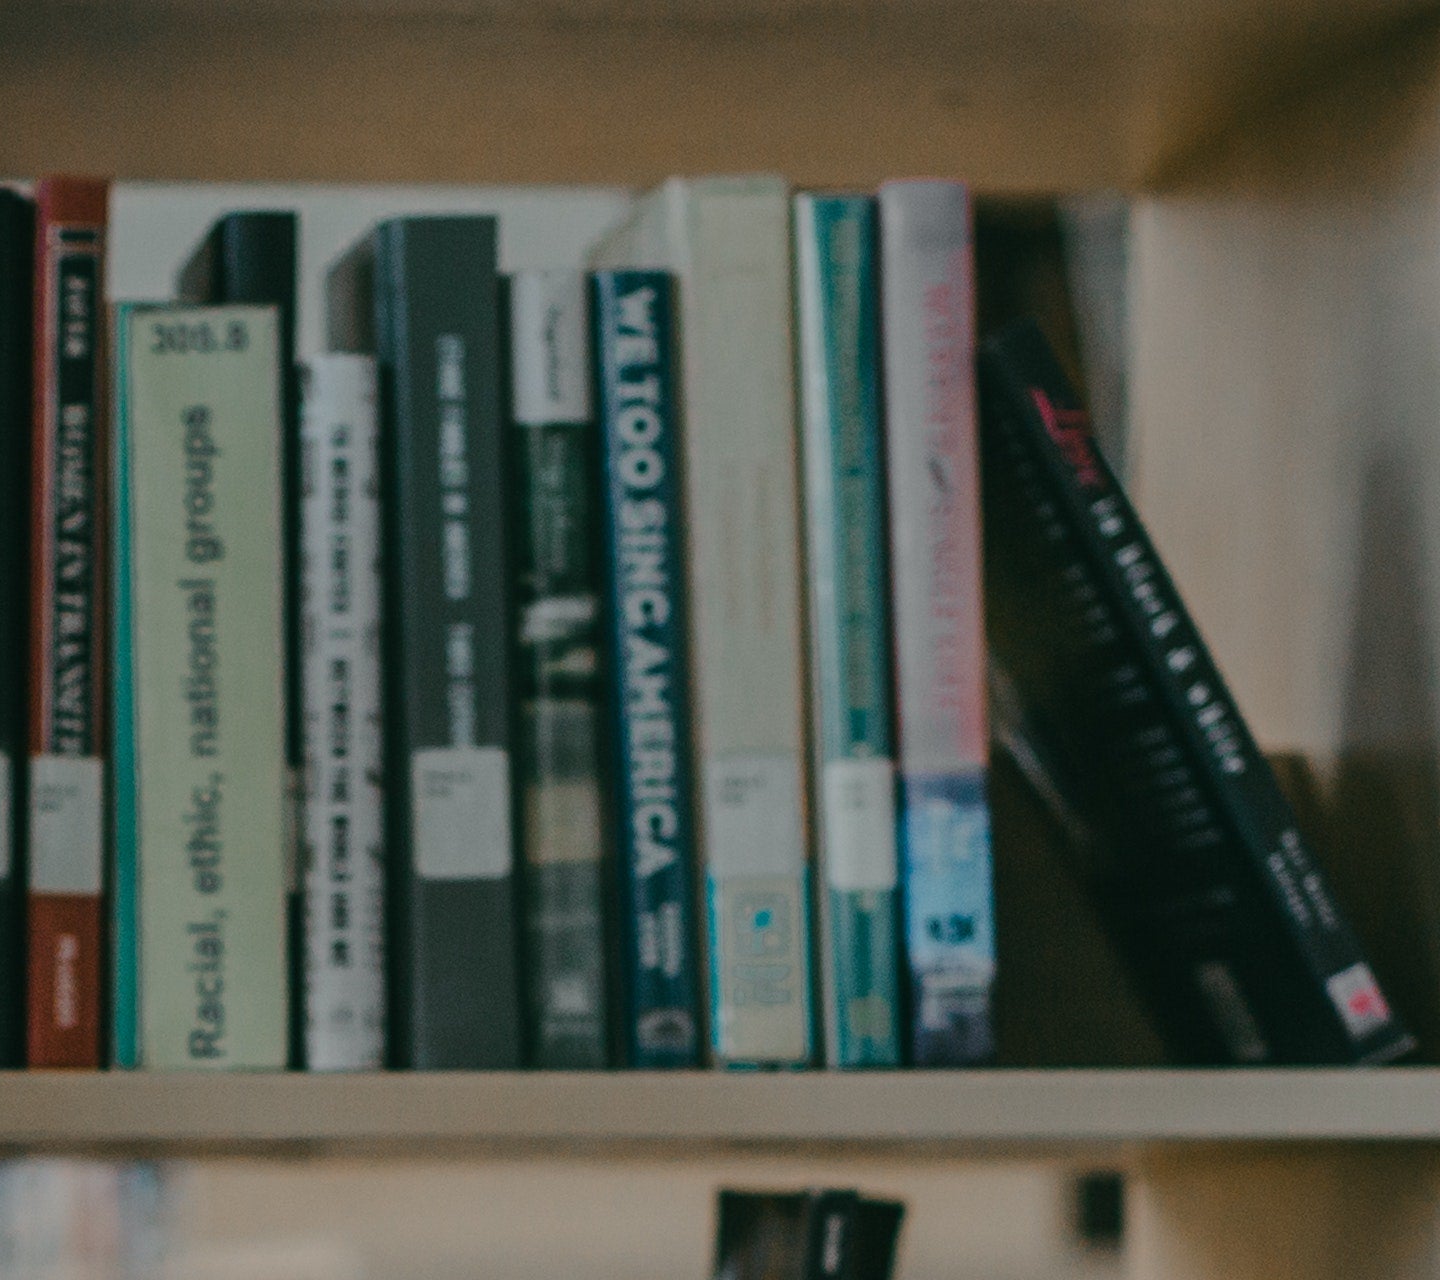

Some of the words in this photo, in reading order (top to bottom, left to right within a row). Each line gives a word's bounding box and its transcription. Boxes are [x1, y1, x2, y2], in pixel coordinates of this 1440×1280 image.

[177, 404, 227, 565] groups
[615, 375, 664, 488] TOO
[620, 497, 669, 626] SING
[174, 576, 218, 759] national
[623, 636, 676, 879] AMERICA
[183, 906, 228, 1060] Racial,
